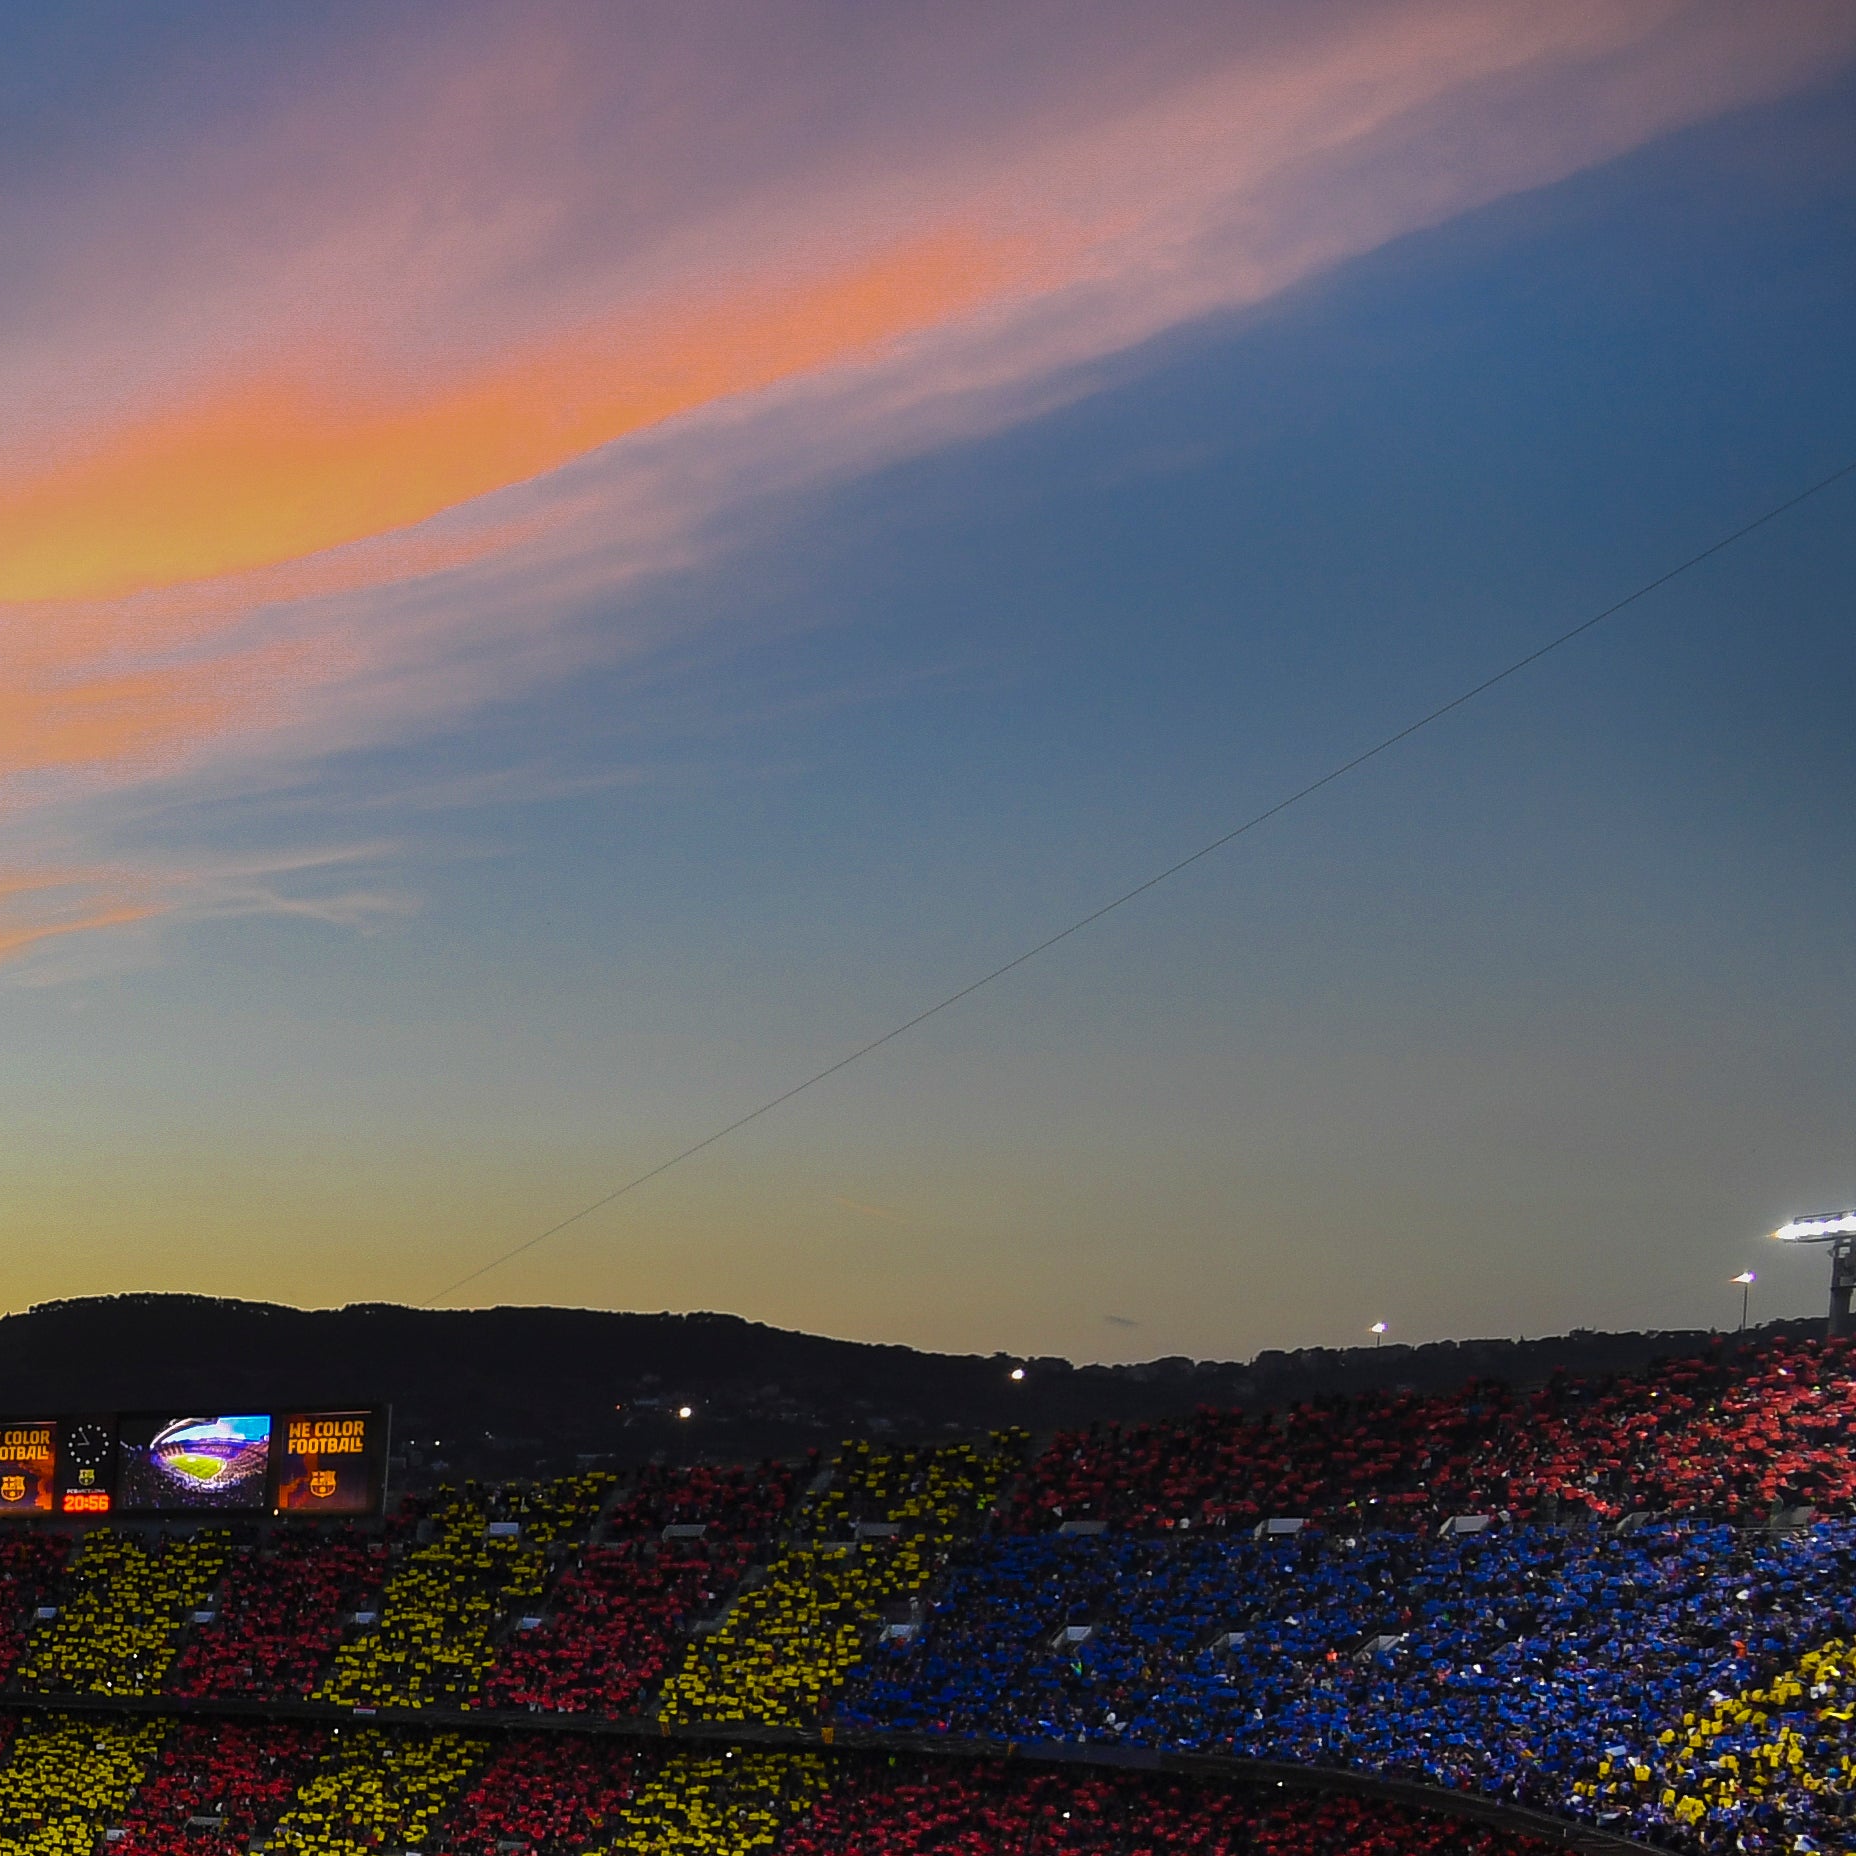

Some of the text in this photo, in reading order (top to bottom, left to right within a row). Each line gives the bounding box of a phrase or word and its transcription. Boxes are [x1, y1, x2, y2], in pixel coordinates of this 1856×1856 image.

[4, 1430, 50, 1445] COLOR
[289, 1420, 365, 1438] WE COLOR
[288, 1437, 364, 1455] FOOTBALL
[63, 1494, 110, 1511] 20:56
